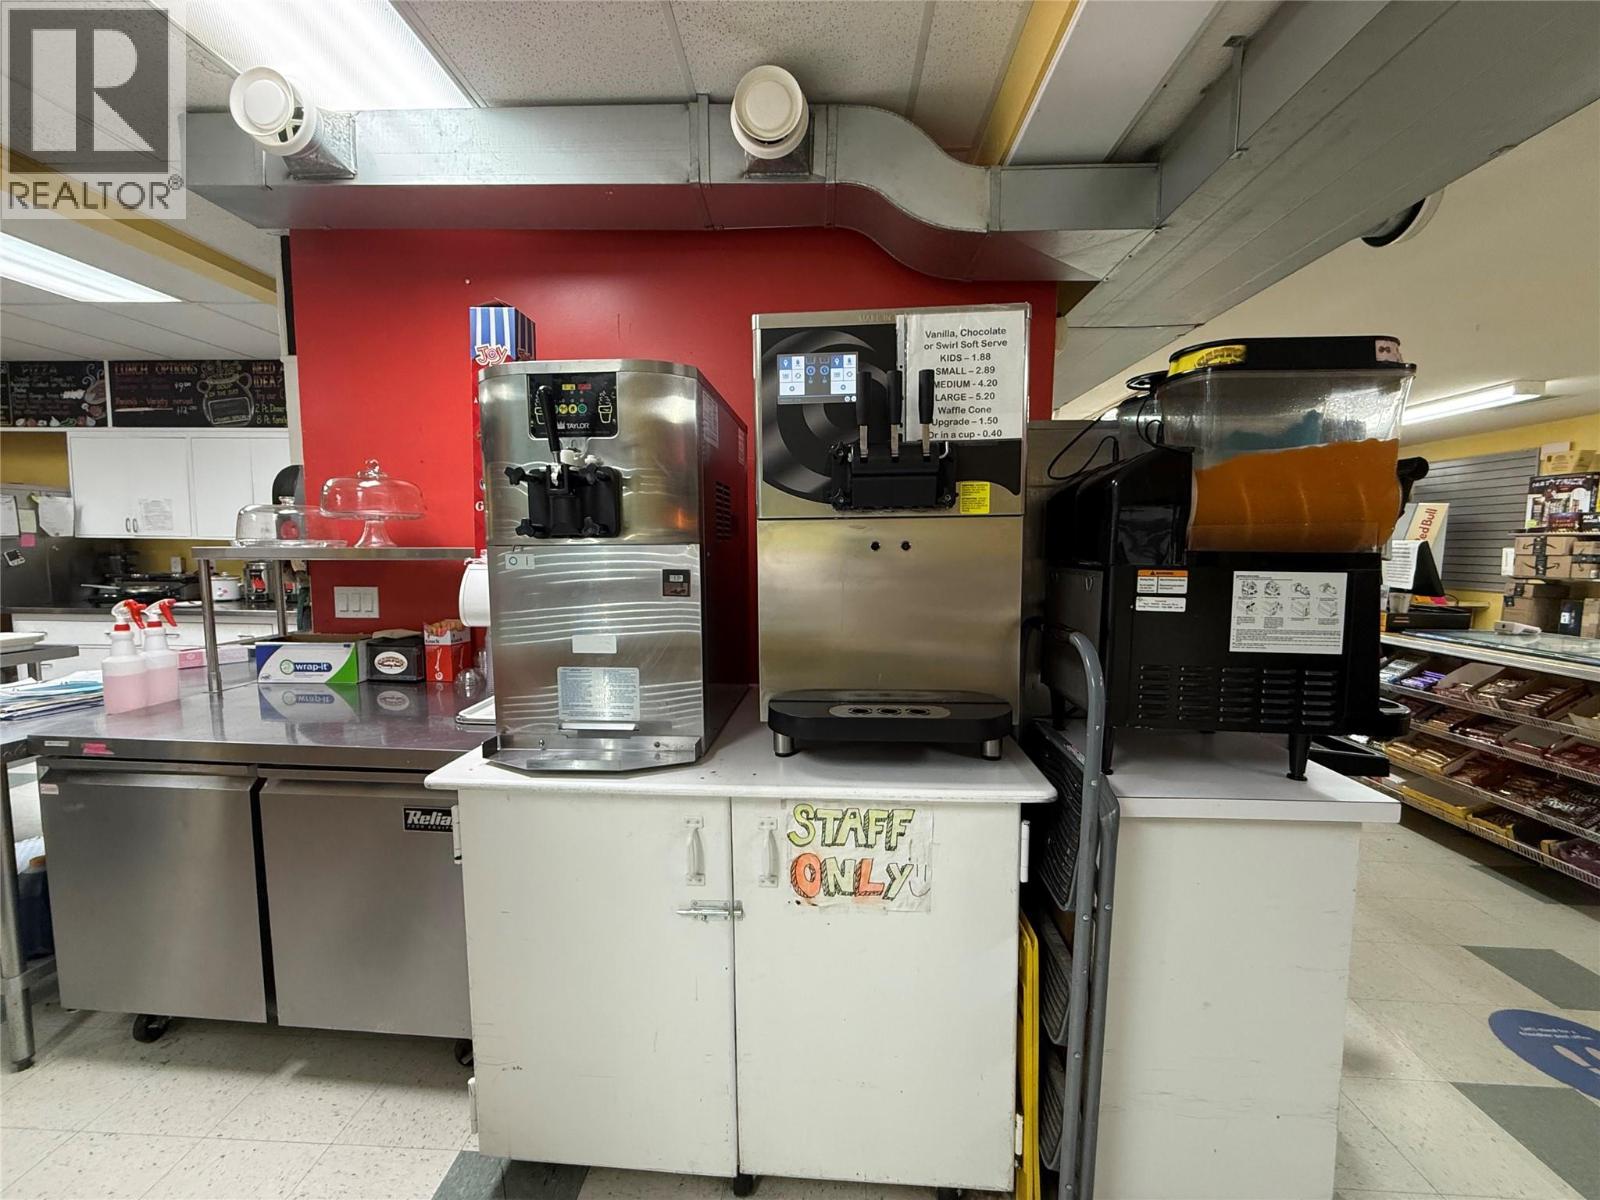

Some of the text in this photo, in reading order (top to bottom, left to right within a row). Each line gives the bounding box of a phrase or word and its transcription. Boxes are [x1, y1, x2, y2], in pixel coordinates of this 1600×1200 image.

[925, 327, 1007, 339] Vanilla, Chocolate
[936, 341, 959, 350] Swirl
[960, 340, 979, 349] Soft
[981, 339, 1008, 348] Serve
[940, 353, 963, 362] KIDS
[972, 352, 991, 361] 1.88
[114, 362, 149, 375] LUNCH
[935, 366, 967, 376] SMALL
[976, 365, 996, 375] 2.89
[933, 380, 971, 389] MEDIUM
[977, 378, 998, 387] 4.20
[935, 393, 967, 402] LARGE
[975, 391, 996, 400] 5.20
[937, 405, 992, 415] Waffle Cone
[931, 417, 970, 428] Upgrade
[979, 416, 999, 425] 1.50
[940, 431, 949, 439] in
[958, 431, 975, 441] cup
[982, 429, 1003, 438] 0.40
[405, 809, 453, 826] Relia
[786, 803, 915, 851] STAFF
[790, 852, 914, 901] ONLY
